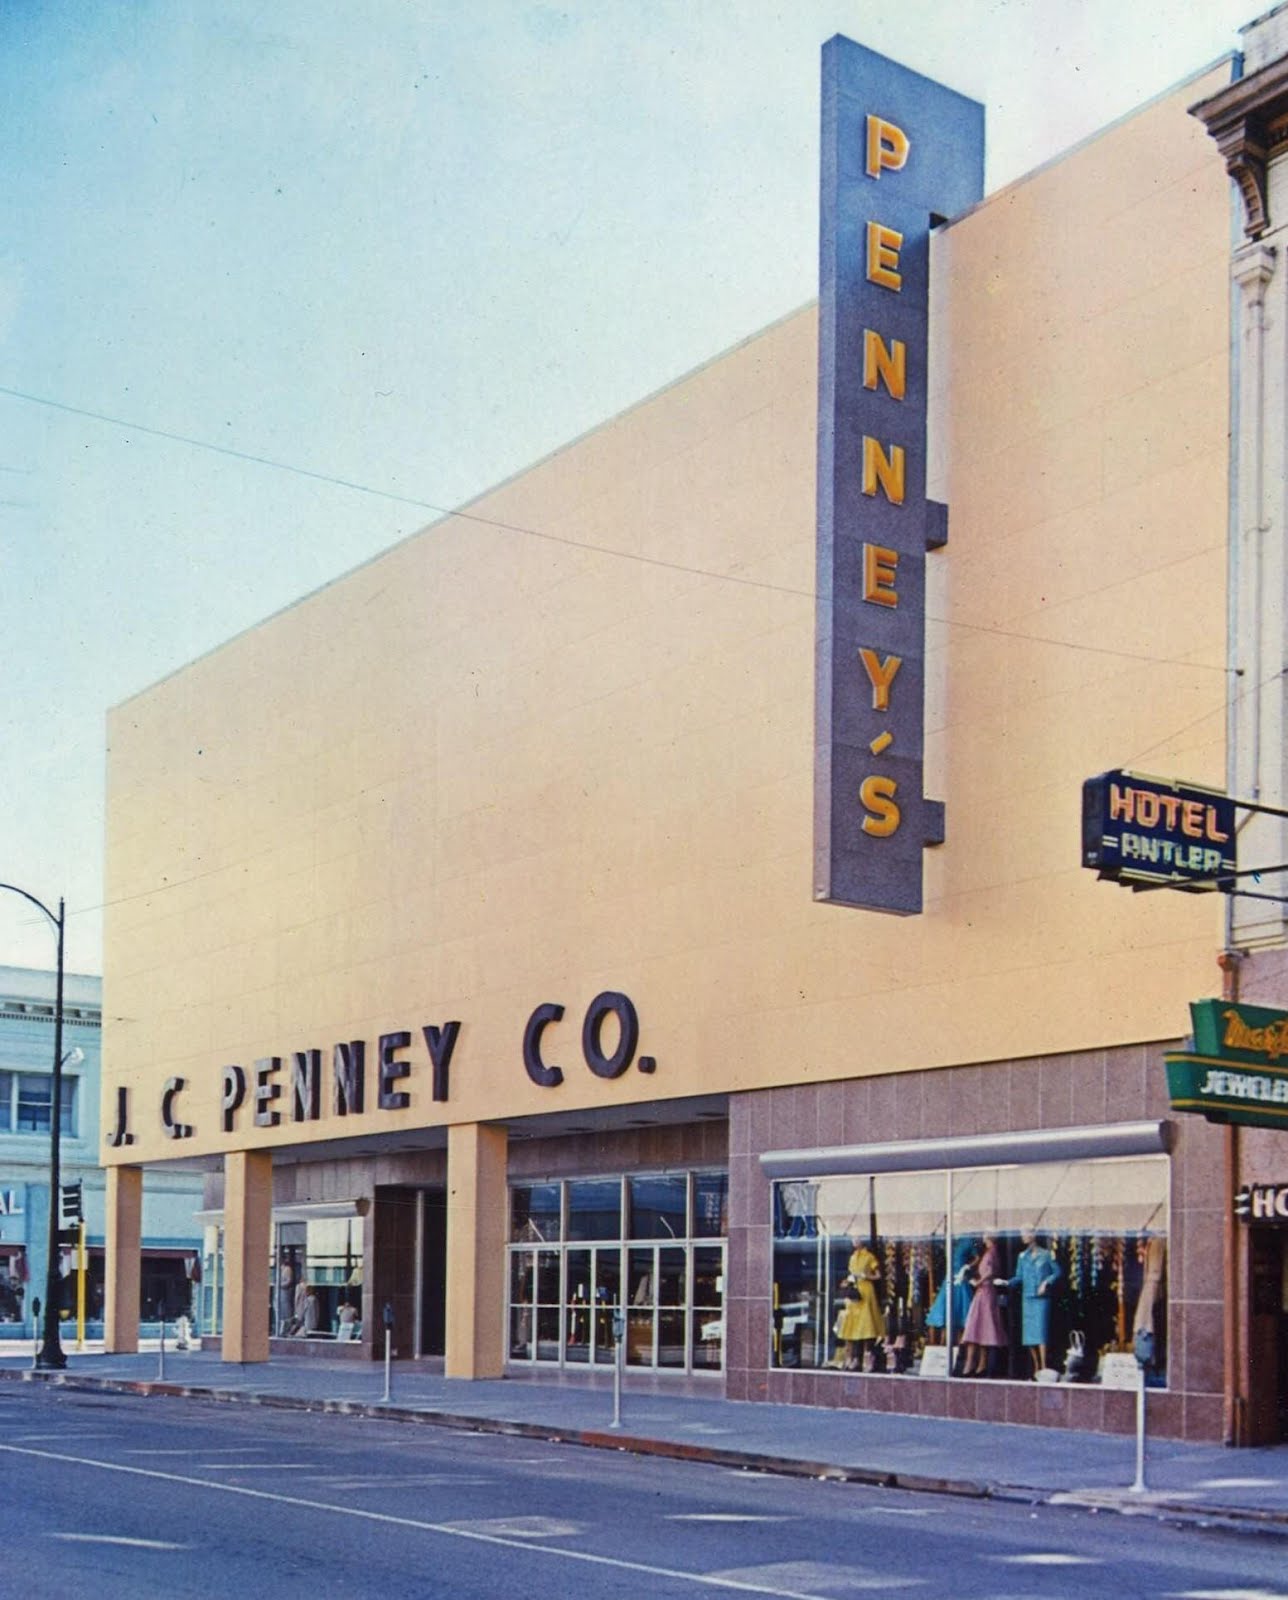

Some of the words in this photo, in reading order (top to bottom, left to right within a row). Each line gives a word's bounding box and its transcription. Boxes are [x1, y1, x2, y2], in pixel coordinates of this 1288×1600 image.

[860, 114, 910, 838] PENNEY'S
[1110, 783, 1229, 843] HOTEL
[106, 1086, 134, 1147] J.
[161, 1076, 193, 1139] C.
[221, 1021, 462, 1132] PENNEY
[522, 991, 656, 1087] CO.
[1200, 1070, 1288, 1104] JEWELE
